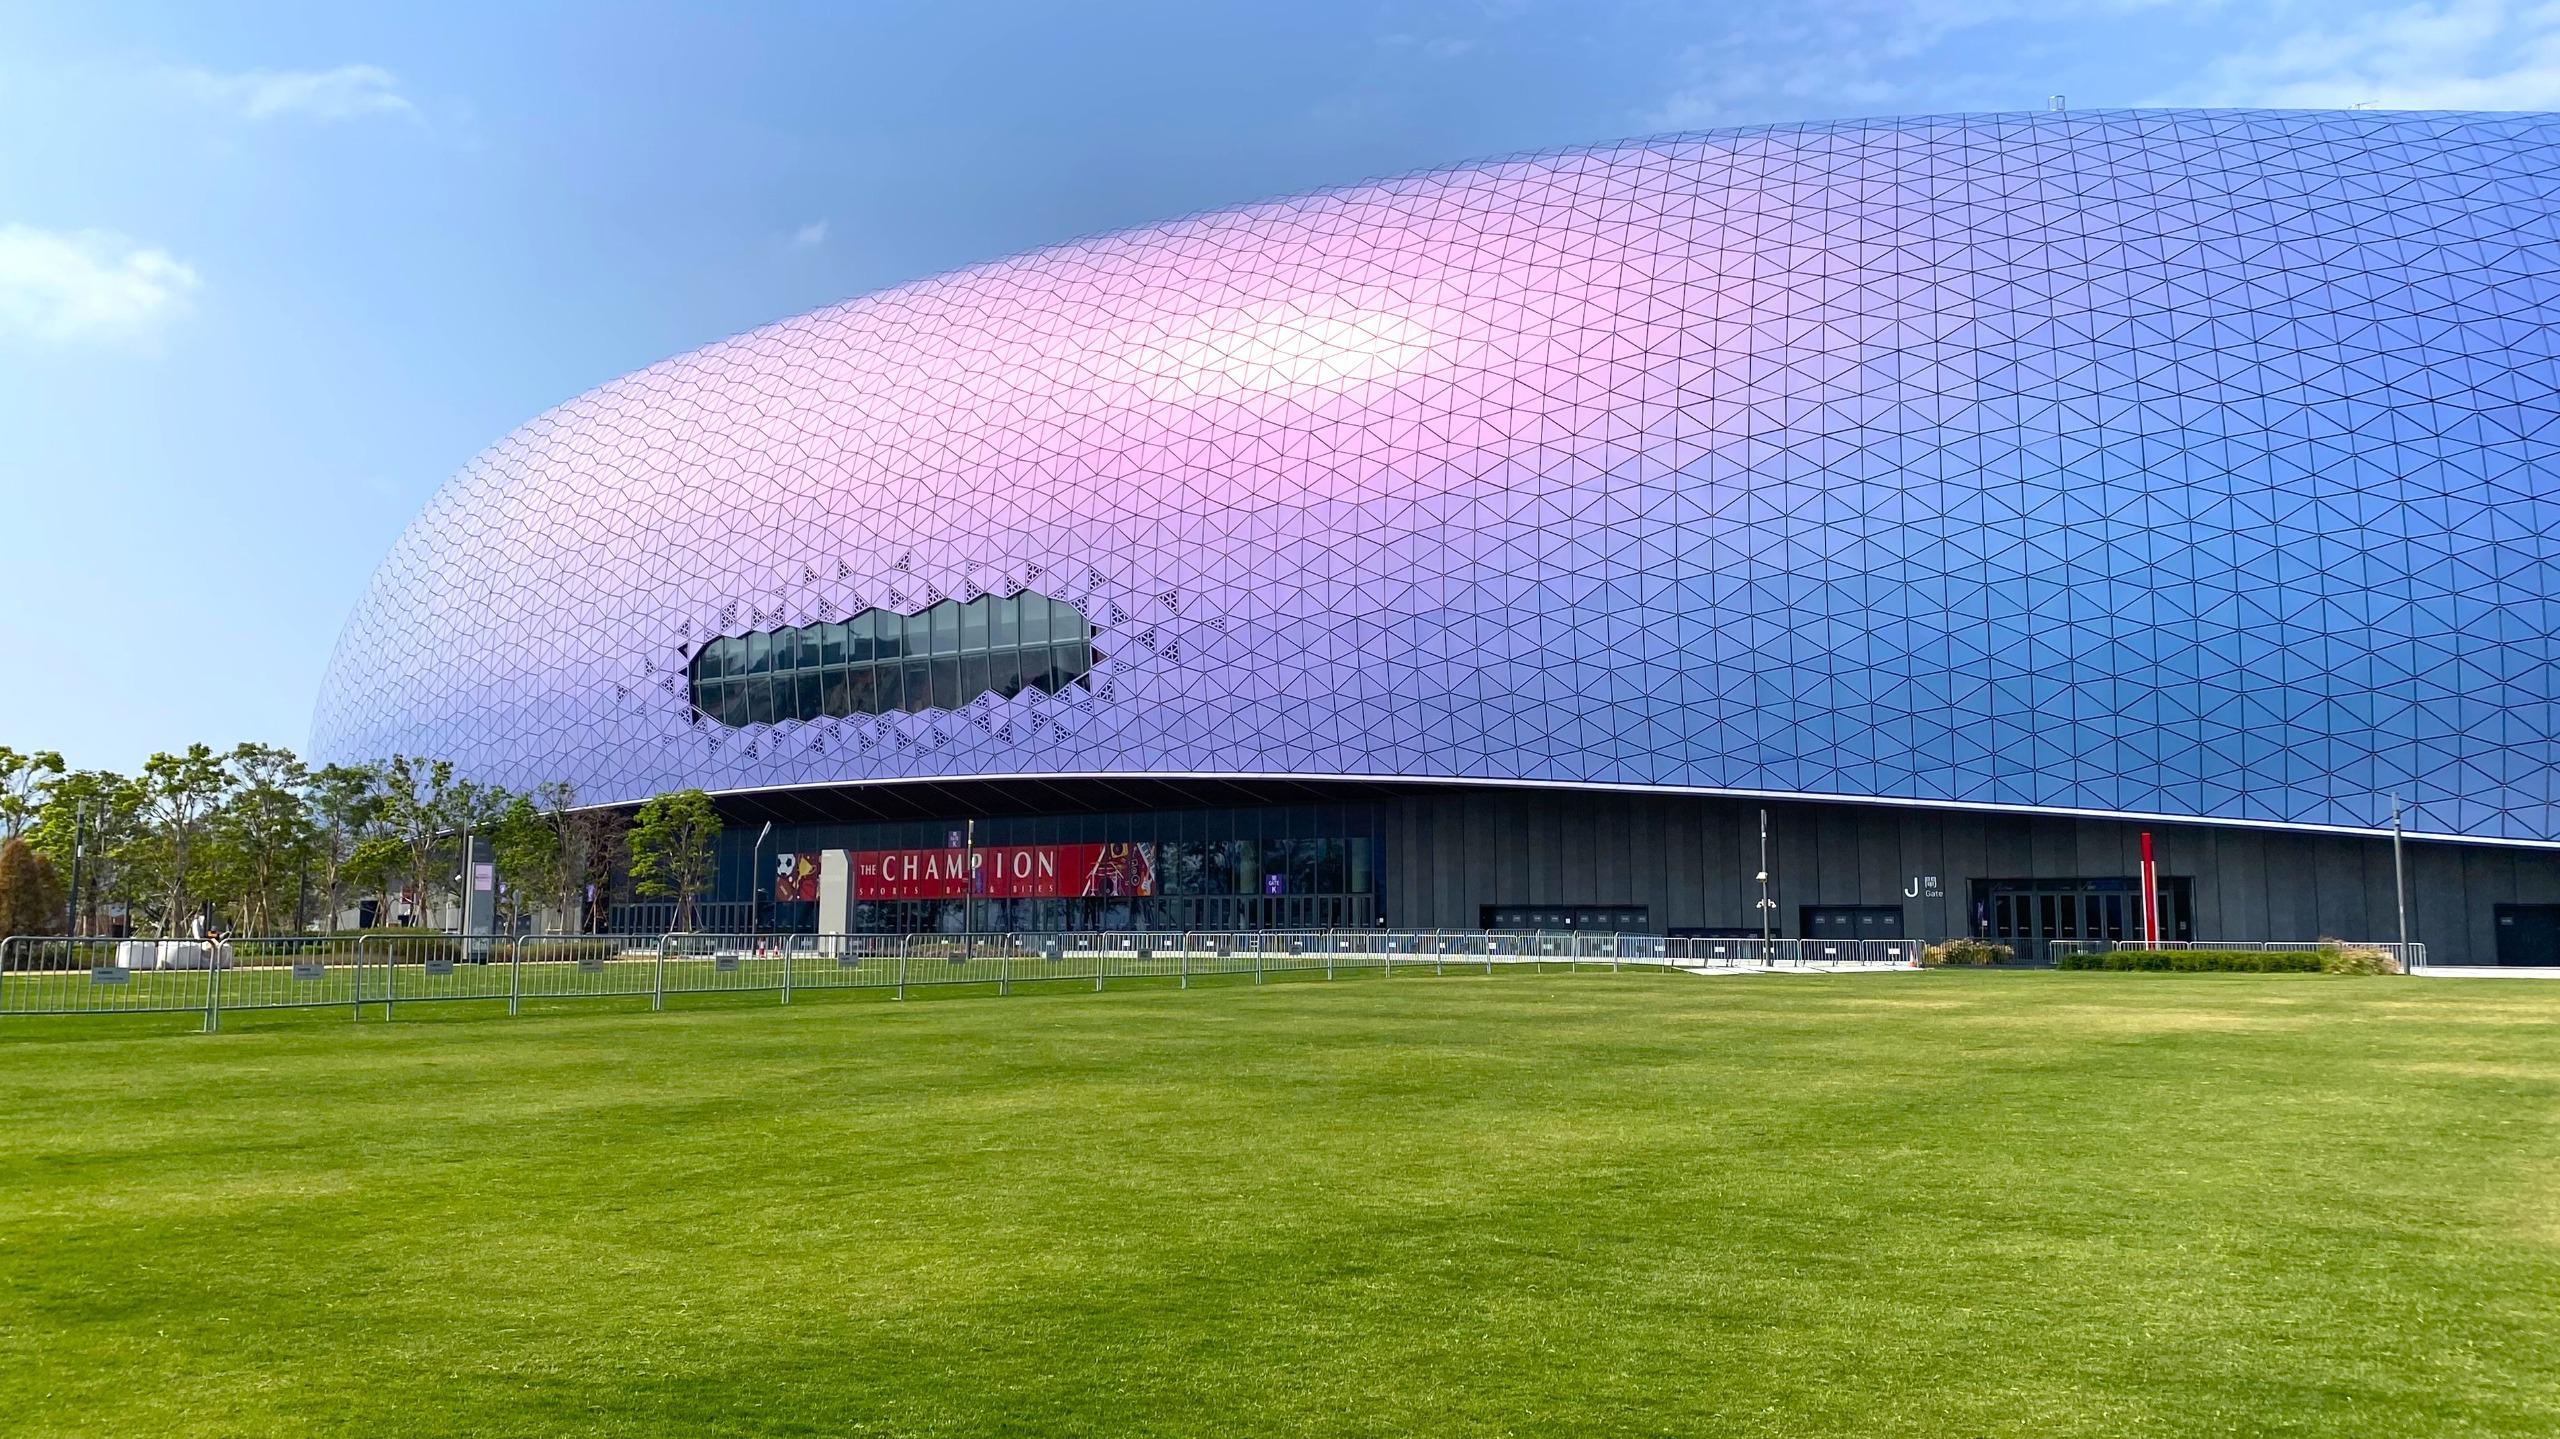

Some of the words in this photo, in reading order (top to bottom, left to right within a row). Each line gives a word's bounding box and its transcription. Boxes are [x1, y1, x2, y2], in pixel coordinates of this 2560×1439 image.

[861, 864, 876, 876] THE
[882, 851, 1054, 881] CHAMPION
[859, 886, 919, 896] SPORTS
[1012, 885, 1053, 893] BITES
[1904, 877, 1919, 898] J
[1925, 890, 1944, 898] Gate
